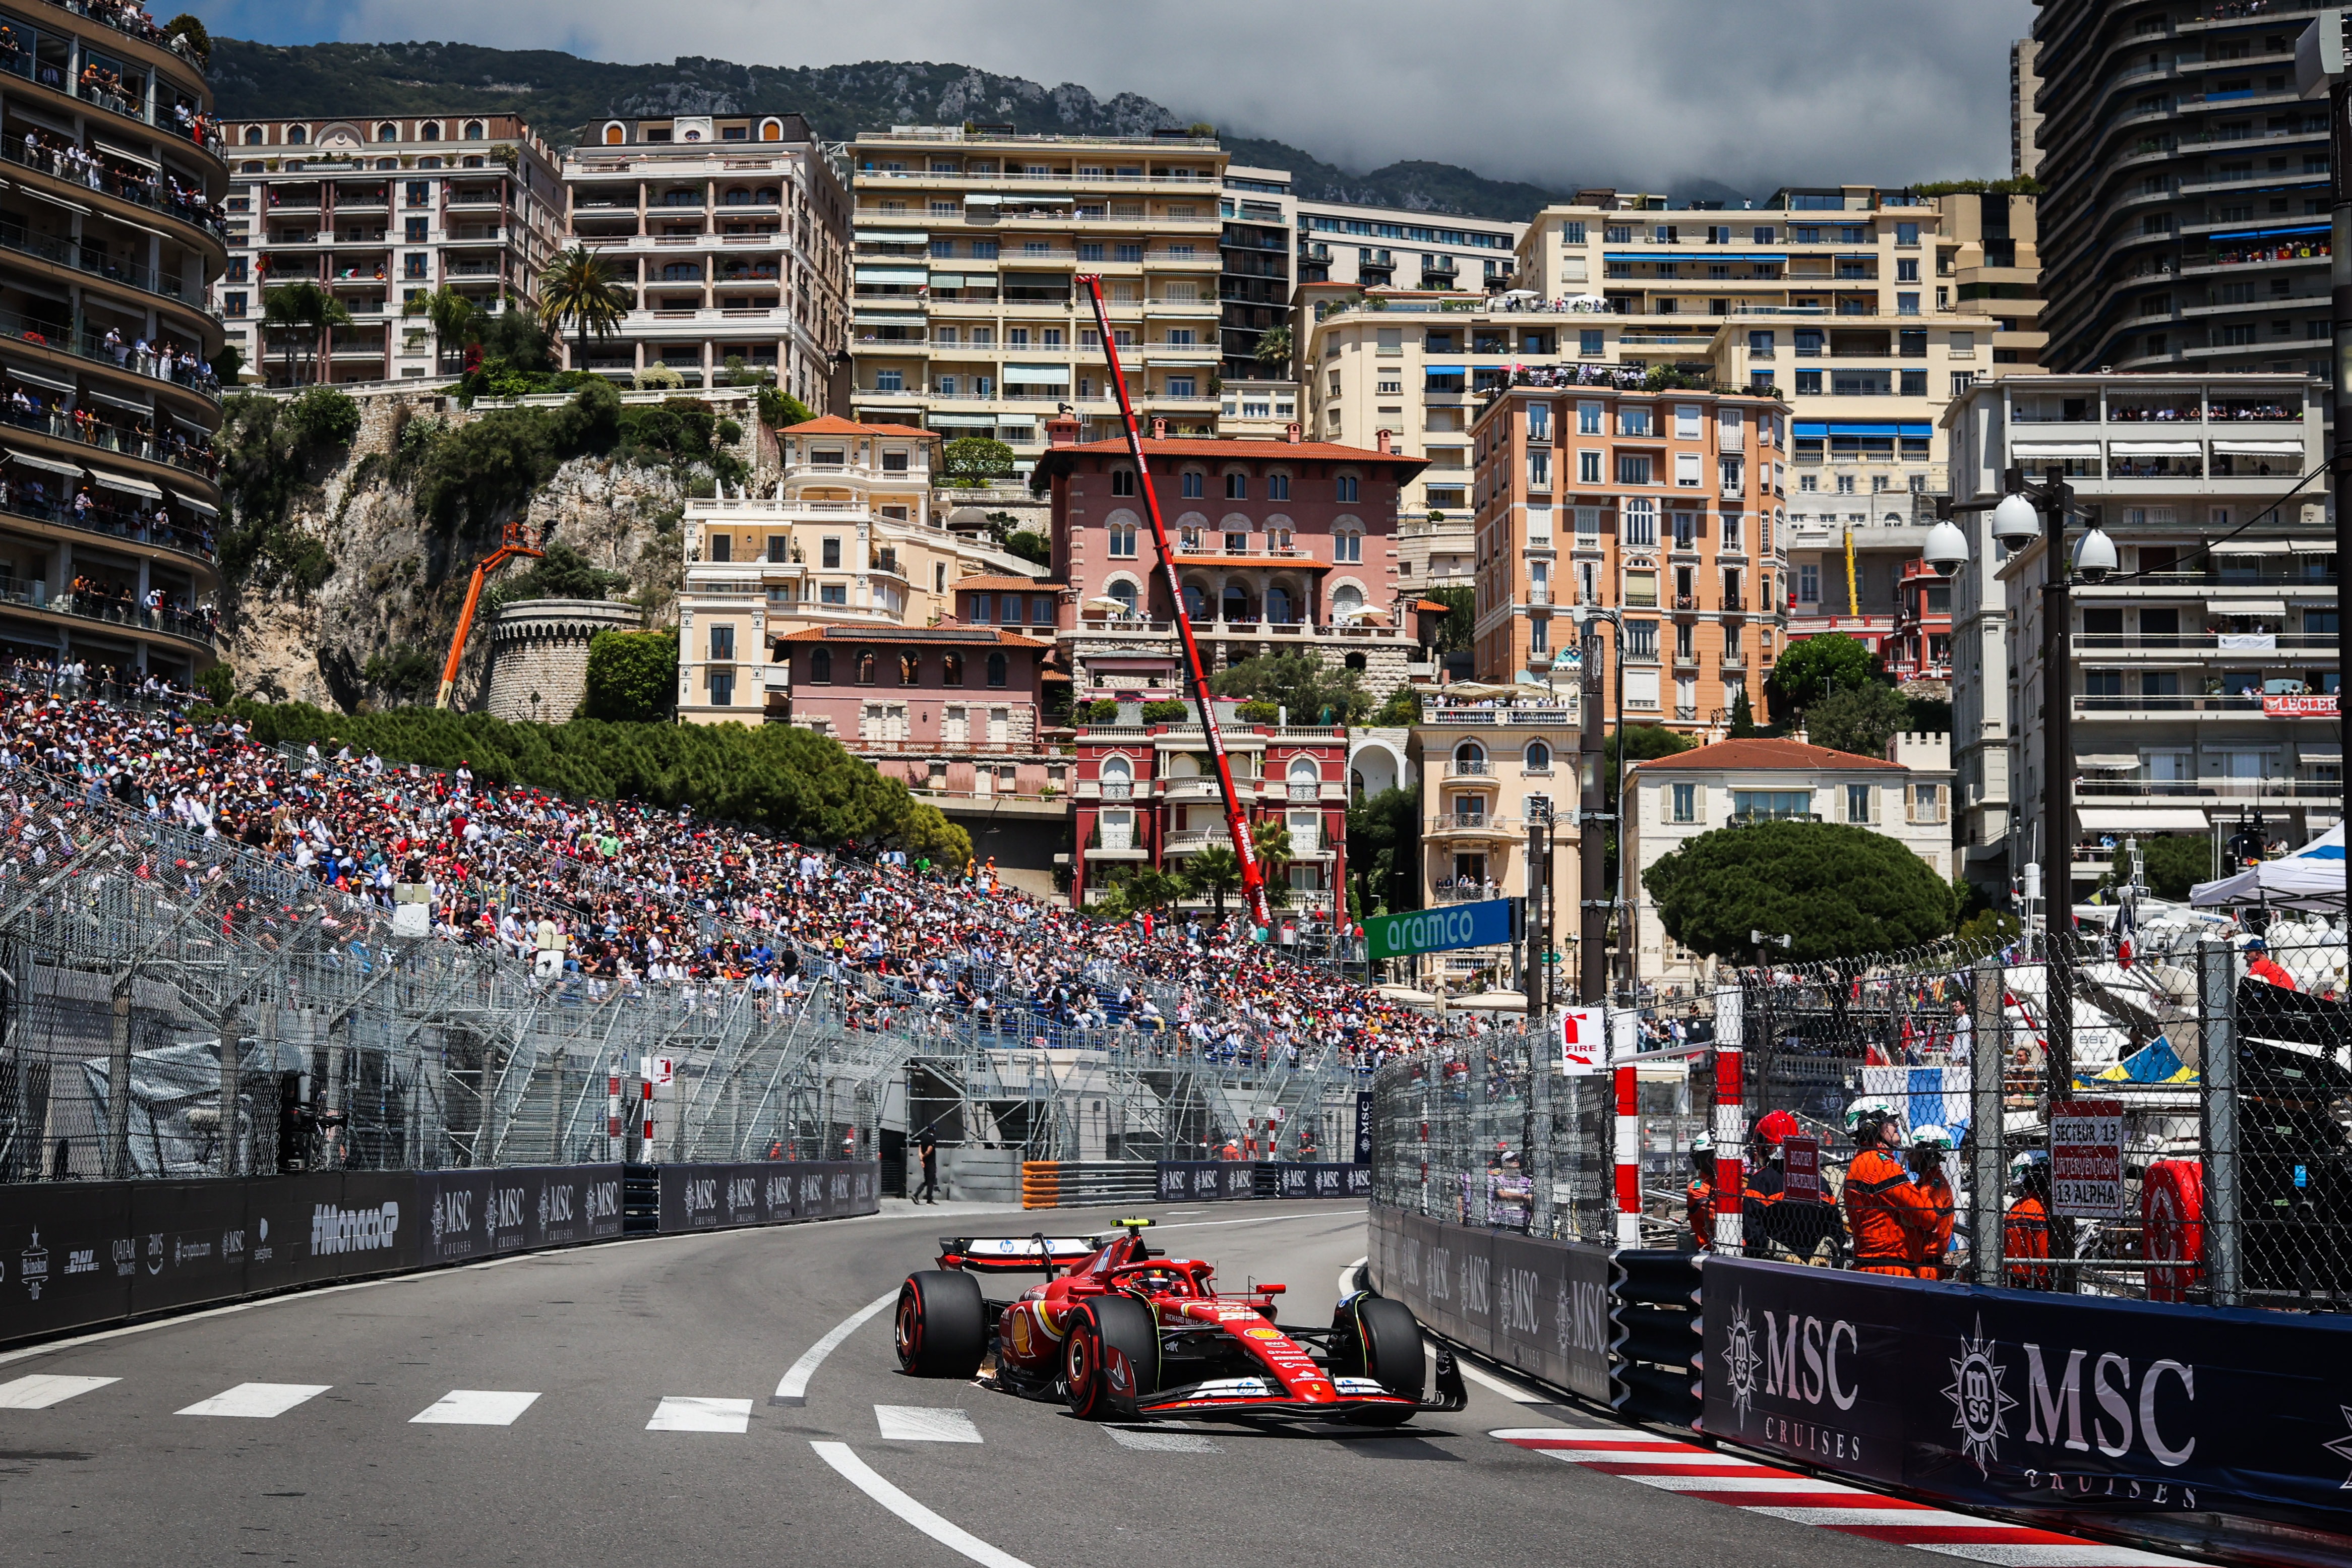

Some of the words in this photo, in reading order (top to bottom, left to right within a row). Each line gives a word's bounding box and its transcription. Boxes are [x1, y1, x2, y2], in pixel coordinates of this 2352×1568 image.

[1131, 431, 1141, 454] IMPERIAL
[1137, 455, 1147, 473] LEVAGE
[1167, 564, 1179, 591] IMPERIAL
[1174, 592, 1185, 614] LEVAGE
[2278, 697, 2337, 711] LECLER
[1202, 697, 1216, 730] IMPERIAL
[1211, 730, 1224, 756] LEVAGE
[1237, 822, 1255, 865] IMPERIAL
[2199, 915, 2223, 923] FURUNO
[1387, 910, 1474, 951] aramco
[1361, 1101, 1369, 1134] MSC
[2055, 1124, 2095, 1142] SECTEUR
[2103, 1124, 2117, 1142] 13
[1676, 1158, 1687, 1171] SC
[2056, 1157, 2117, 1175] INTERVENTION
[807, 1174, 822, 1201] MSC
[837, 1174, 850, 1198] MSC
[1169, 1171, 1185, 1189] MSC
[1201, 1170, 1217, 1188] MSC
[1236, 1170, 1251, 1188] MSC
[1290, 1170, 1306, 1187] MSC
[1323, 1171, 1339, 1187] MSC
[1355, 1170, 1371, 1186] MSC
[596, 1181, 618, 1217] MSC
[695, 1179, 716, 1210] MSC
[737, 1178, 755, 1207] MSC
[774, 1176, 791, 1204] MSC
[2057, 1185, 2070, 1203] 13
[2075, 1185, 2116, 1203] ALPHA
[446, 1190, 471, 1233] MSC
[499, 1188, 524, 1227] MSC
[550, 1185, 573, 1222] MSC
[596, 1223, 618, 1235] CRUISES
[695, 1216, 716, 1225] CRUISES
[737, 1214, 755, 1223] CRUISES
[148, 1233, 163, 1255] aws
[229, 1230, 245, 1253] MSC
[498, 1234, 524, 1248] CRUISES
[550, 1229, 573, 1241] CRUISES
[112, 1239, 135, 1265] QATAR
[182, 1241, 211, 1260] crypto.com
[255, 1245, 272, 1263] salesforce
[444, 1240, 471, 1255] CRUISES
[1000, 1240, 1014, 1253] hp
[22, 1257, 47, 1275] Heineken
[69, 1249, 96, 1273] DHL
[117, 1262, 135, 1276] AIRWAYS
[1433, 1246, 1450, 1300] MSC
[1469, 1255, 1490, 1315] MSC
[1513, 1268, 1539, 1335] MSC
[1165, 1313, 1184, 1323] RICHARD
[1218, 1312, 1260, 1322] 55
[1573, 1281, 1607, 1354] MSC
[1764, 1310, 1858, 1411] MSC
[2023, 1343, 2196, 1468] MSC
[1765, 1416, 1860, 1462] CRUISES
[2024, 1468, 2196, 1509] CRUISES
